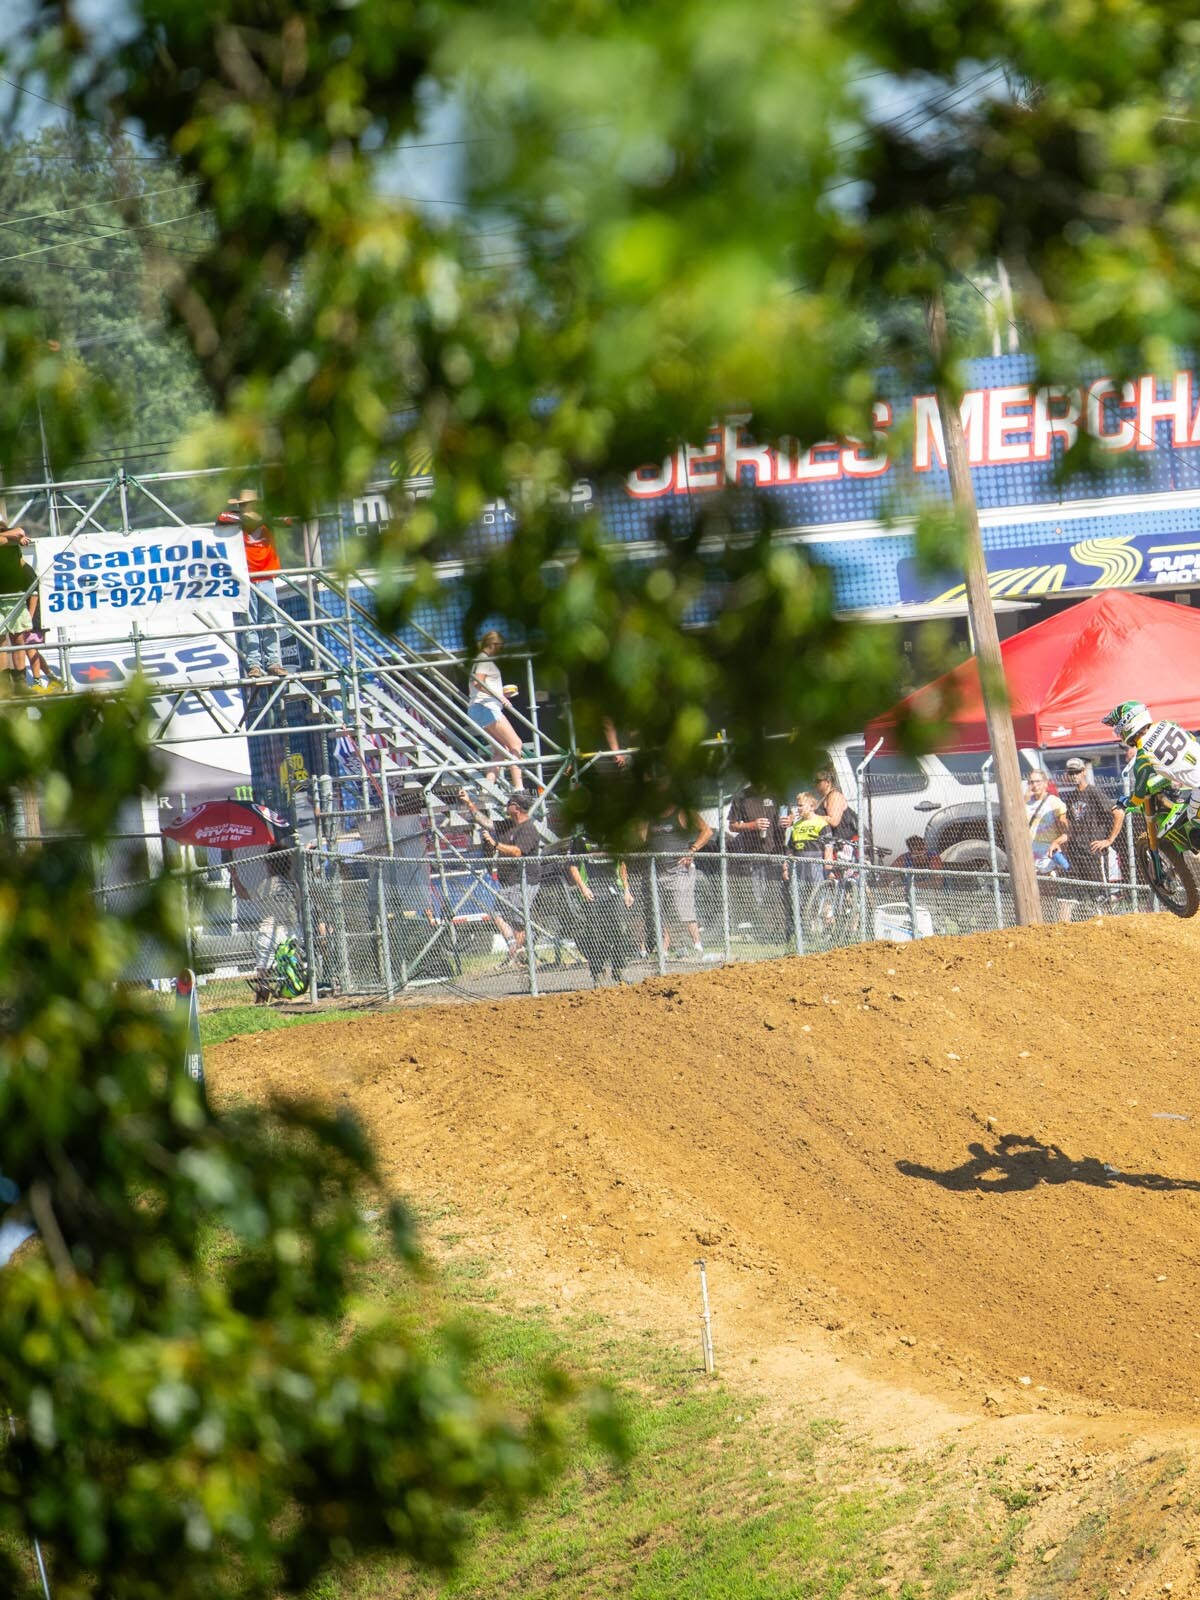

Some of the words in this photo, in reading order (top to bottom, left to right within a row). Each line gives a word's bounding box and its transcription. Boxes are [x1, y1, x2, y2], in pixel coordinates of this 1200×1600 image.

[53, 540, 228, 572] Scaffold
[53, 563, 232, 592] Resource
[48, 579, 240, 613] 301-924-7223
[1154, 726, 1187, 766] 55
